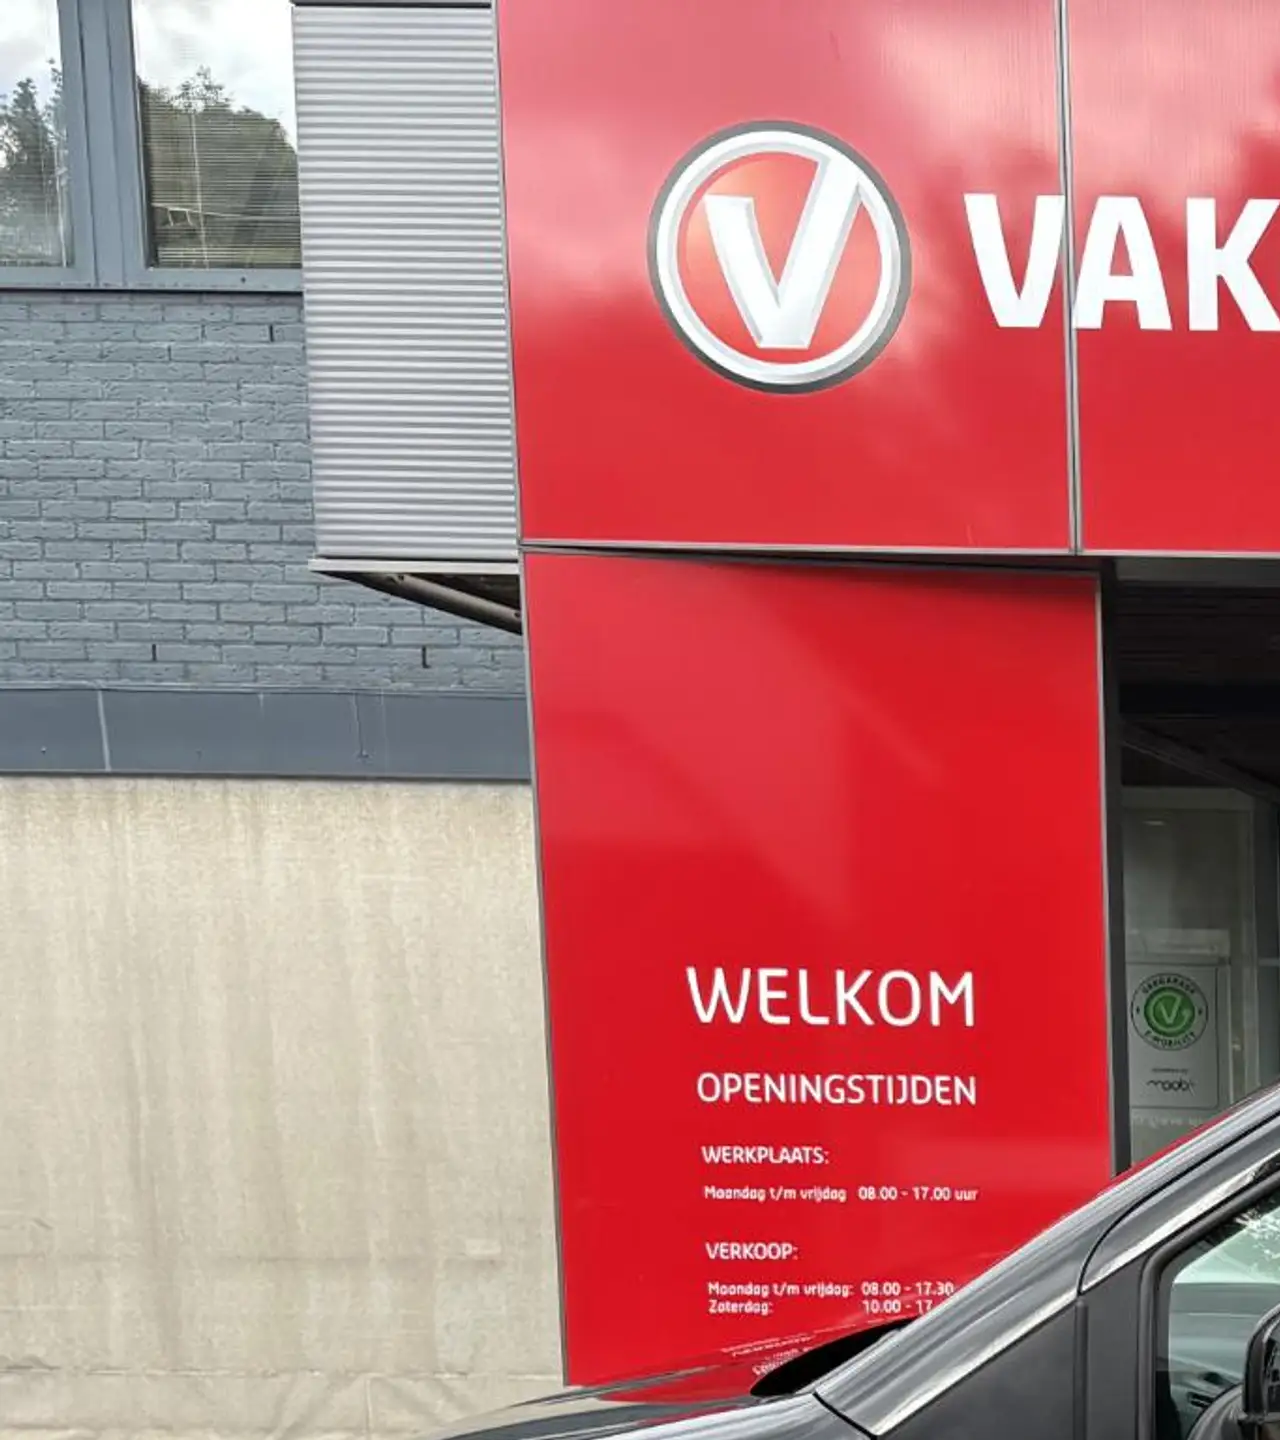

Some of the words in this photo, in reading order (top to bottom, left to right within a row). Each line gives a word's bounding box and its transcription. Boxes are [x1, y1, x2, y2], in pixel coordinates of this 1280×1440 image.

[685, 966, 975, 1027] WELKOM
[696, 1071, 977, 1106] OPENINGSTIJDEN
[701, 1145, 829, 1165] WERKPLAATS:
[703, 1185, 766, 1202] Maandag
[769, 1185, 797, 1201] t/m
[799, 1186, 847, 1203] vrijdag
[857, 1186, 898, 1201] 08.00
[912, 1186, 952, 1201] 17.00
[954, 1188, 979, 1201] uur
[705, 1242, 799, 1261] VERKOOP:
[707, 1281, 770, 1298] Maandag
[772, 1281, 801, 1297] t/m
[861, 1281, 902, 1296] 08.00
[914, 1281, 955, 1297] 17.30
[708, 1299, 774, 1316] Zaterdag:
[861, 1298, 902, 1314] 10.00
